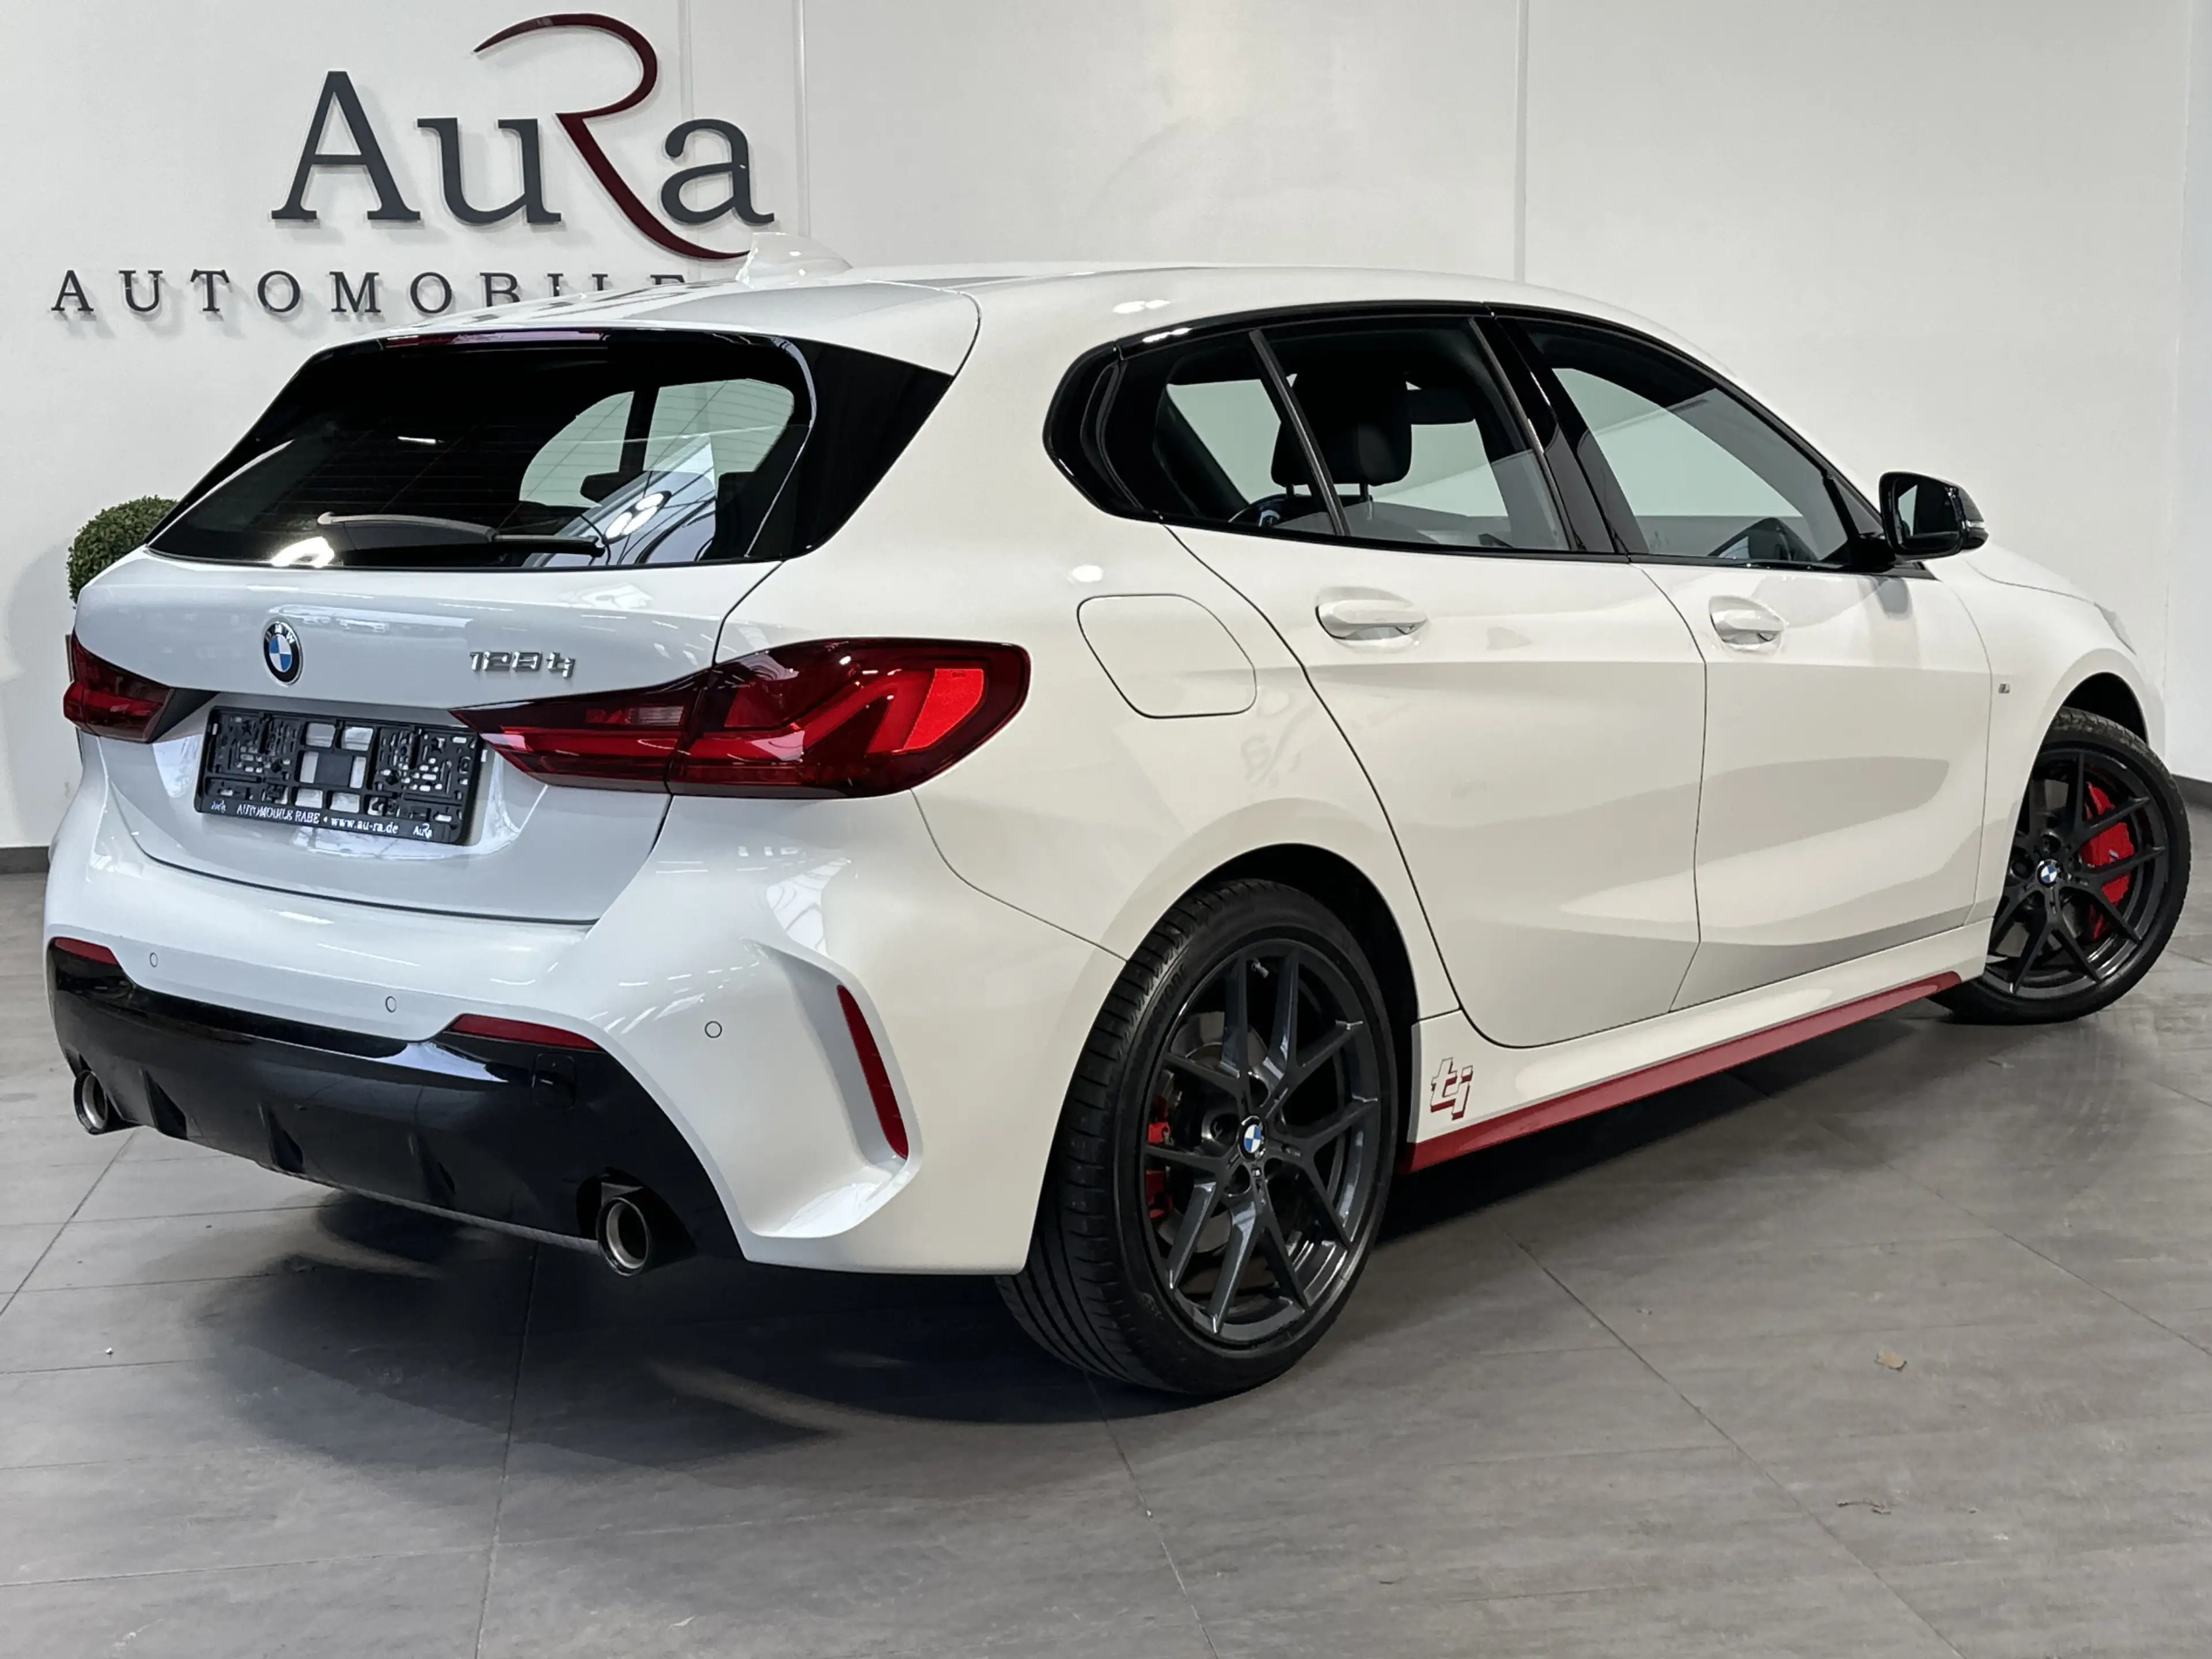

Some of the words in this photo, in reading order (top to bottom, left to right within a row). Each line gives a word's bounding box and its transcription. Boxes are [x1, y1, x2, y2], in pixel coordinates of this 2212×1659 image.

[469, 651, 543, 671] 128
[295, 810, 321, 824] RABE
[331, 817, 399, 834] www.au-ra.de
